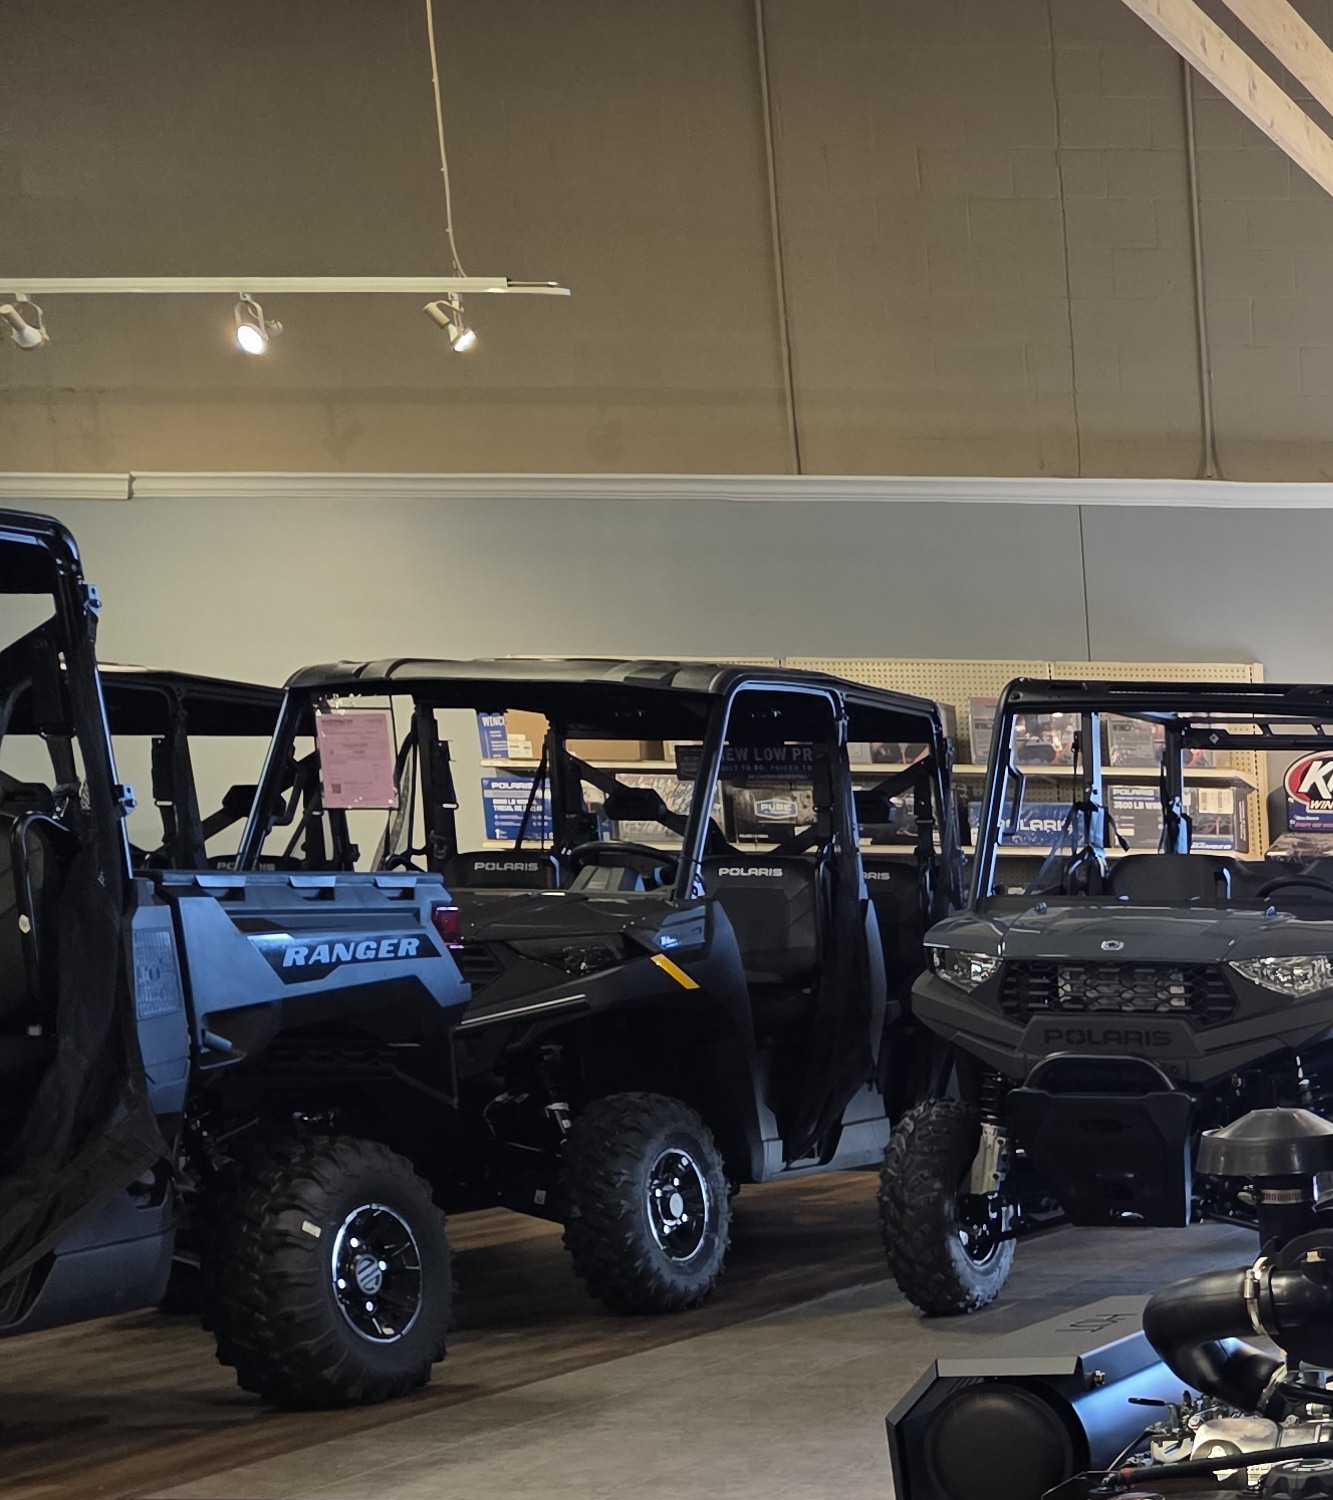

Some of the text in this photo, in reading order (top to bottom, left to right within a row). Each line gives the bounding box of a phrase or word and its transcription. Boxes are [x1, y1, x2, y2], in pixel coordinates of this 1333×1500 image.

[482, 716, 505, 727] WINC
[754, 747, 787, 762] LOW
[1112, 788, 1155, 796] POLARIS
[760, 803, 792, 812] PURE
[1134, 801, 1145, 809] LB
[1145, 802, 1162, 810] WIN
[474, 862, 539, 872] POLARIS
[718, 867, 783, 877] POLARIS
[282, 937, 420, 968] RANGER
[1043, 1028, 1173, 1047] POLARIS
